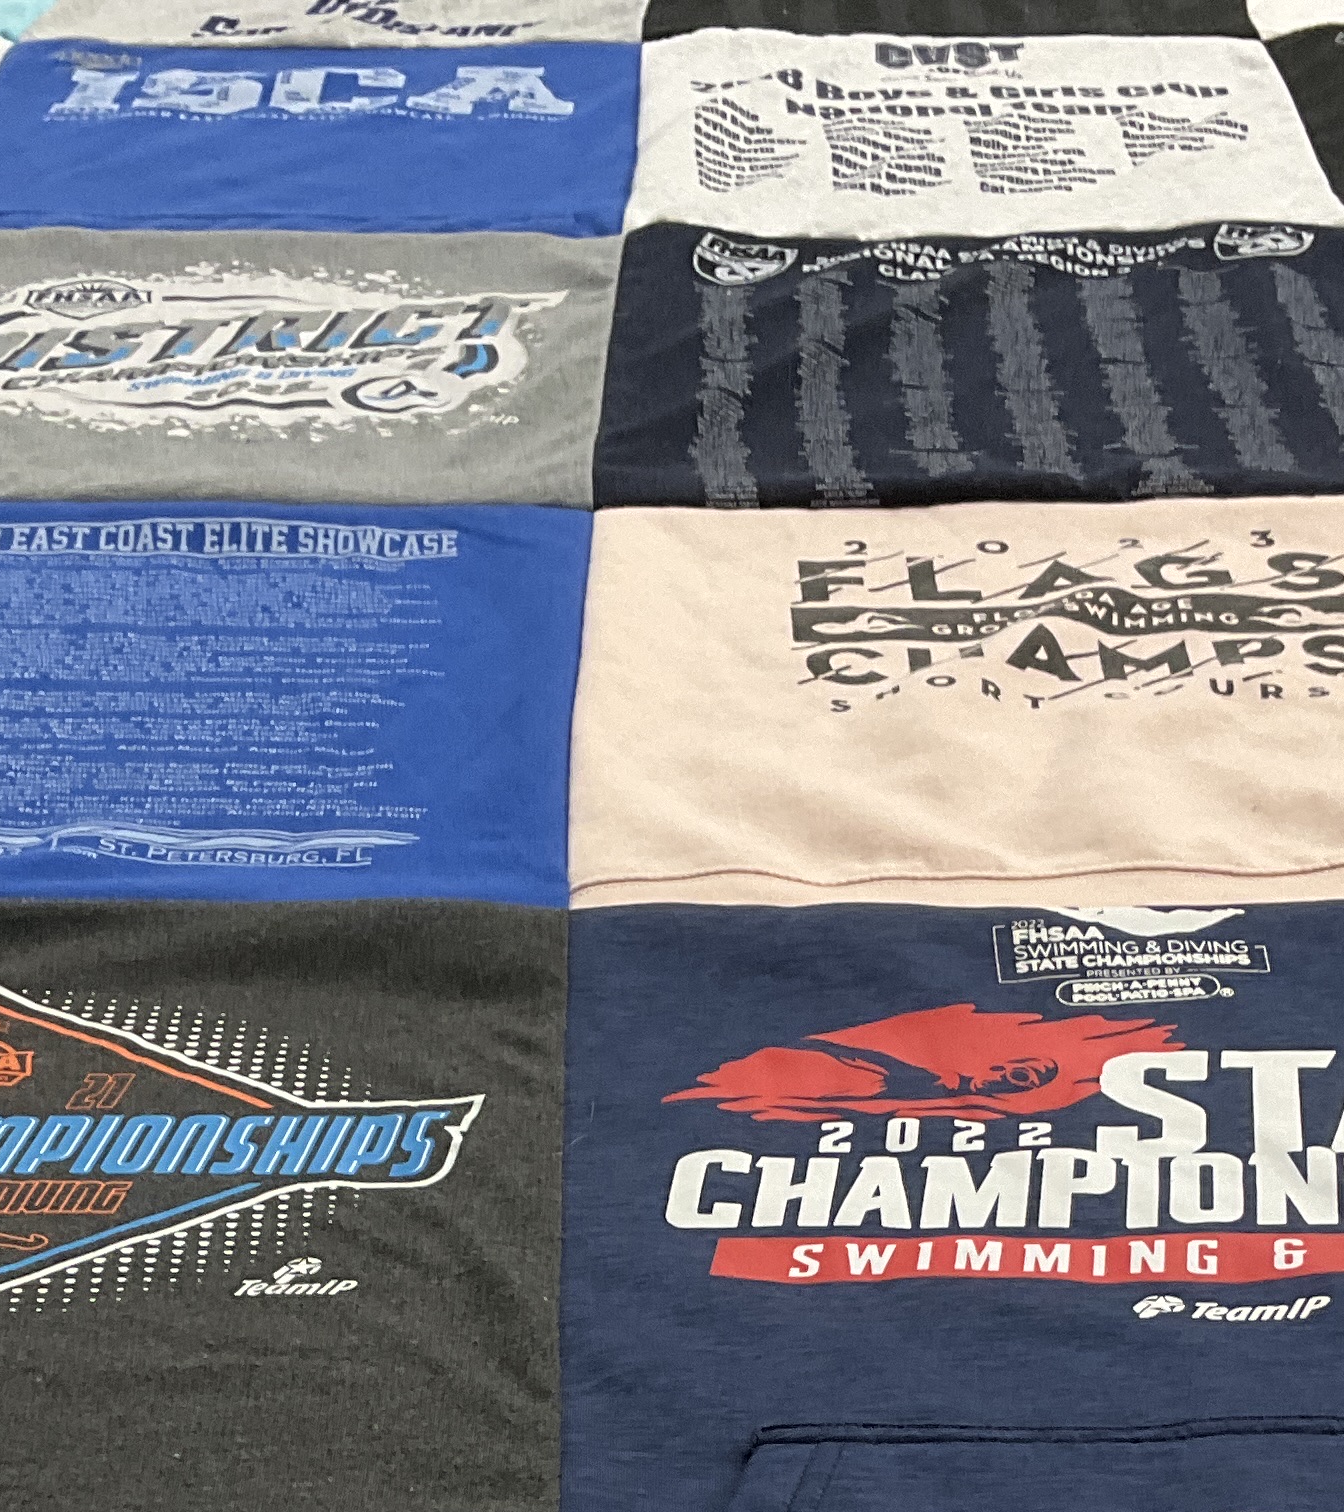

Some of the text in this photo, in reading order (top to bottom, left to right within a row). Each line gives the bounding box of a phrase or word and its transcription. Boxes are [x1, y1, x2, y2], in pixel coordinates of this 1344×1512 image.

[875, 43, 1024, 68] CVST
[50, 67, 574, 115] ISCA
[10, 527, 89, 553] EAST
[99, 526, 193, 552] COAST
[203, 526, 289, 553] ELITE
[297, 527, 459, 558] SHOWCASE
[1131, 597, 1193, 615] AGE
[97, 837, 372, 866] ST. PETERSBURG, FL
[1012, 926, 1104, 945] FHSAA
[1015, 940, 1248, 960] SWIMMING & DIVING
[1015, 953, 1251, 974] STATE CHAMPIONSHIPS
[1086, 966, 1181, 978] PRESENTED BY
[65, 1073, 136, 1110] 21
[818, 1119, 1054, 1153] 2022
[788, 1236, 1221, 1279] SWIMMING
[1272, 1238, 1307, 1274] &
[233, 1276, 359, 1300] TeamIP
[1190, 1292, 1333, 1325] TeamIP
